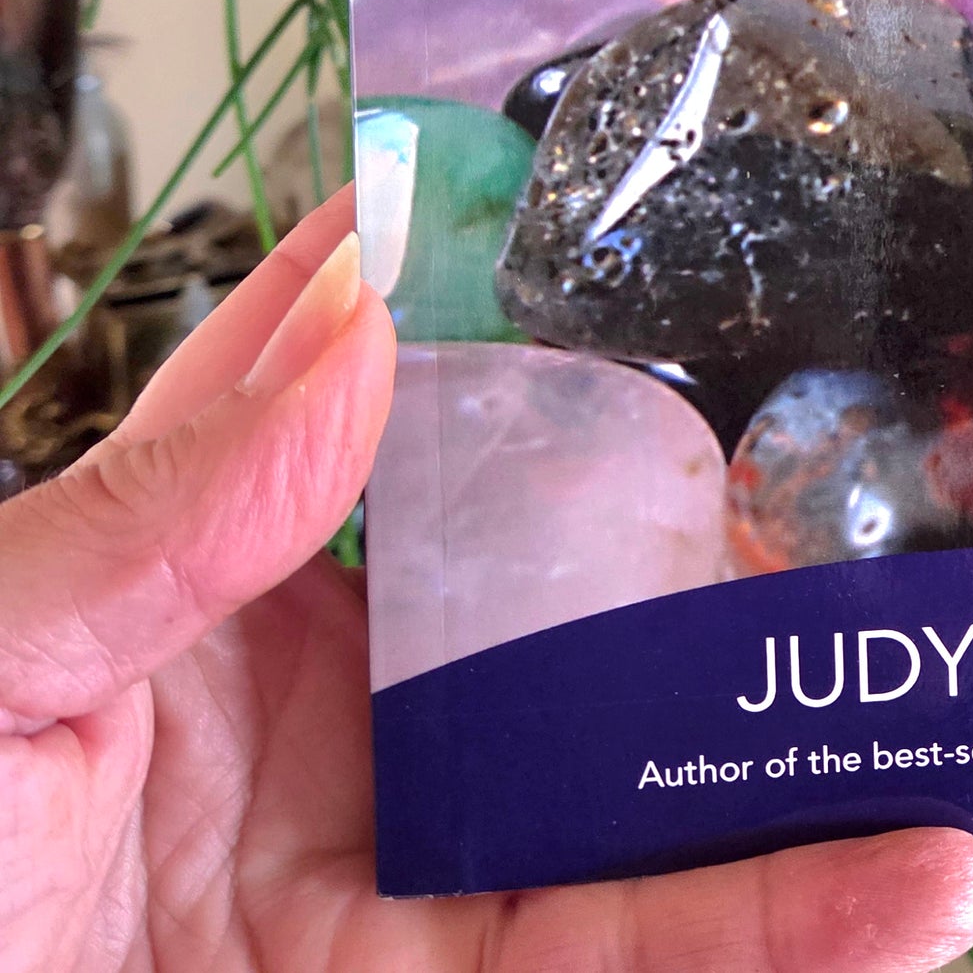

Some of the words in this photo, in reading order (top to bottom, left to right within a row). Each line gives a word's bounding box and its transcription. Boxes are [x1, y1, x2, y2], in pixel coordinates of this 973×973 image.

[637, 754, 754, 790] Author
[765, 746, 799, 779] of
[807, 744, 862, 775] the
